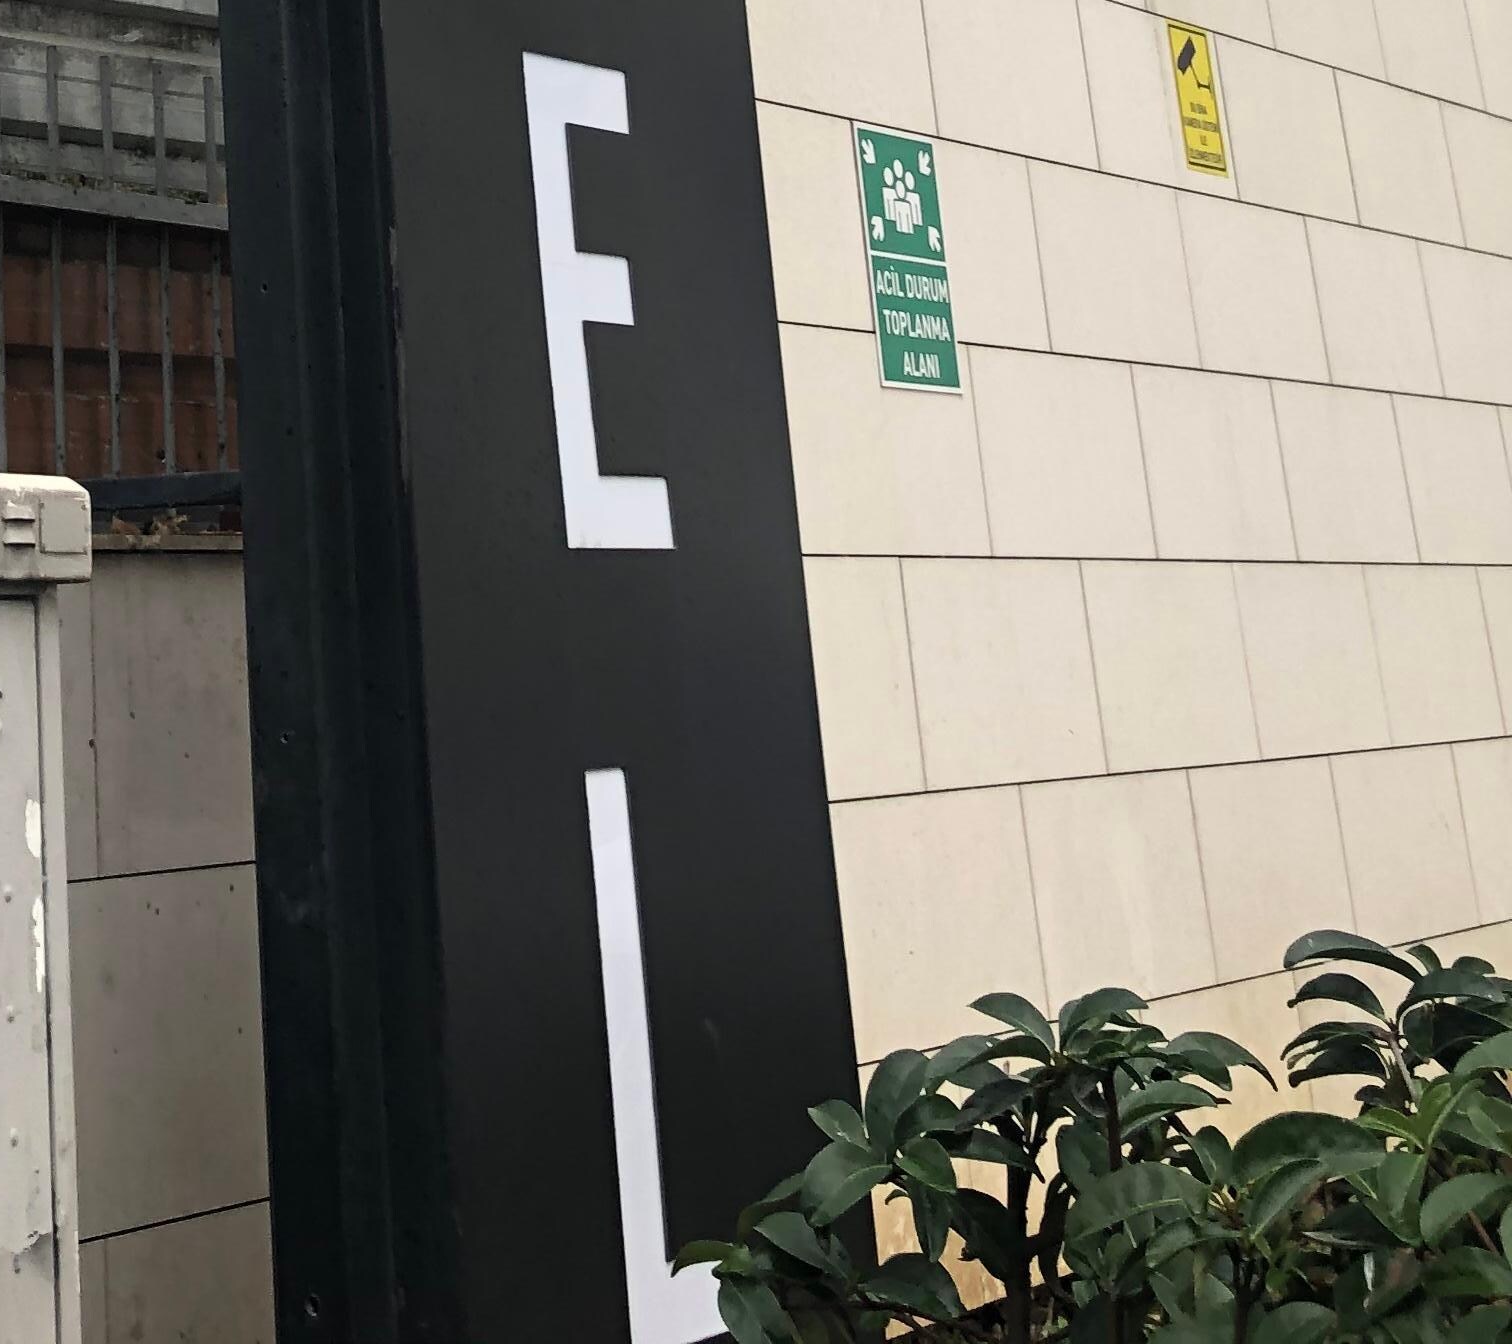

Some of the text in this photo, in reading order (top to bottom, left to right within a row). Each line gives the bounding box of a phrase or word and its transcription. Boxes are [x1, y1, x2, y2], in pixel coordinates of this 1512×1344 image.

[876, 265, 950, 304] ACİL DURUM
[883, 309, 951, 342] TOPLANMA
[903, 351, 941, 379] ALANI
